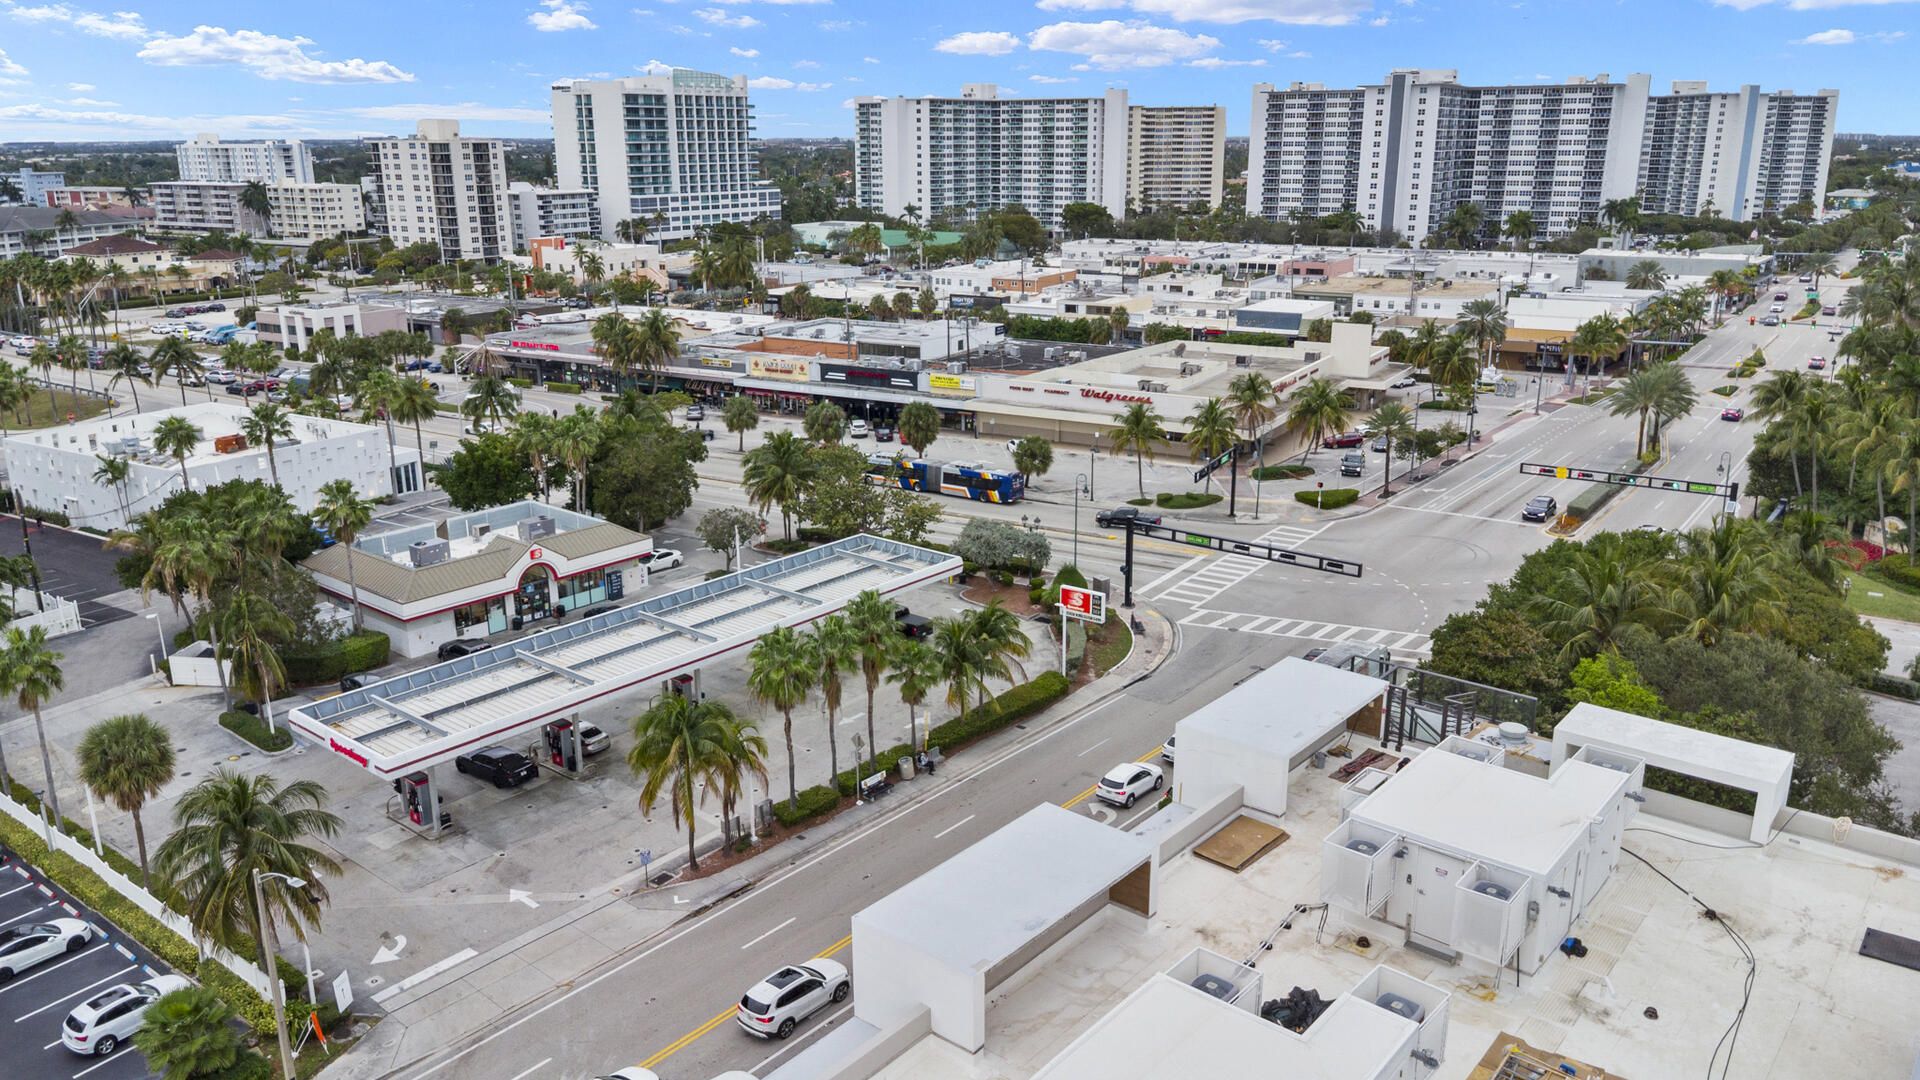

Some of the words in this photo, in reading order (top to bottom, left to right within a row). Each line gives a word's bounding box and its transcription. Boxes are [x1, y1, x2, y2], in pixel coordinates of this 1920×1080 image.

[1044, 388, 1070, 396] PHARMACY
[1079, 388, 1153, 405] Walgreens
[330, 738, 367, 768] Speedway
